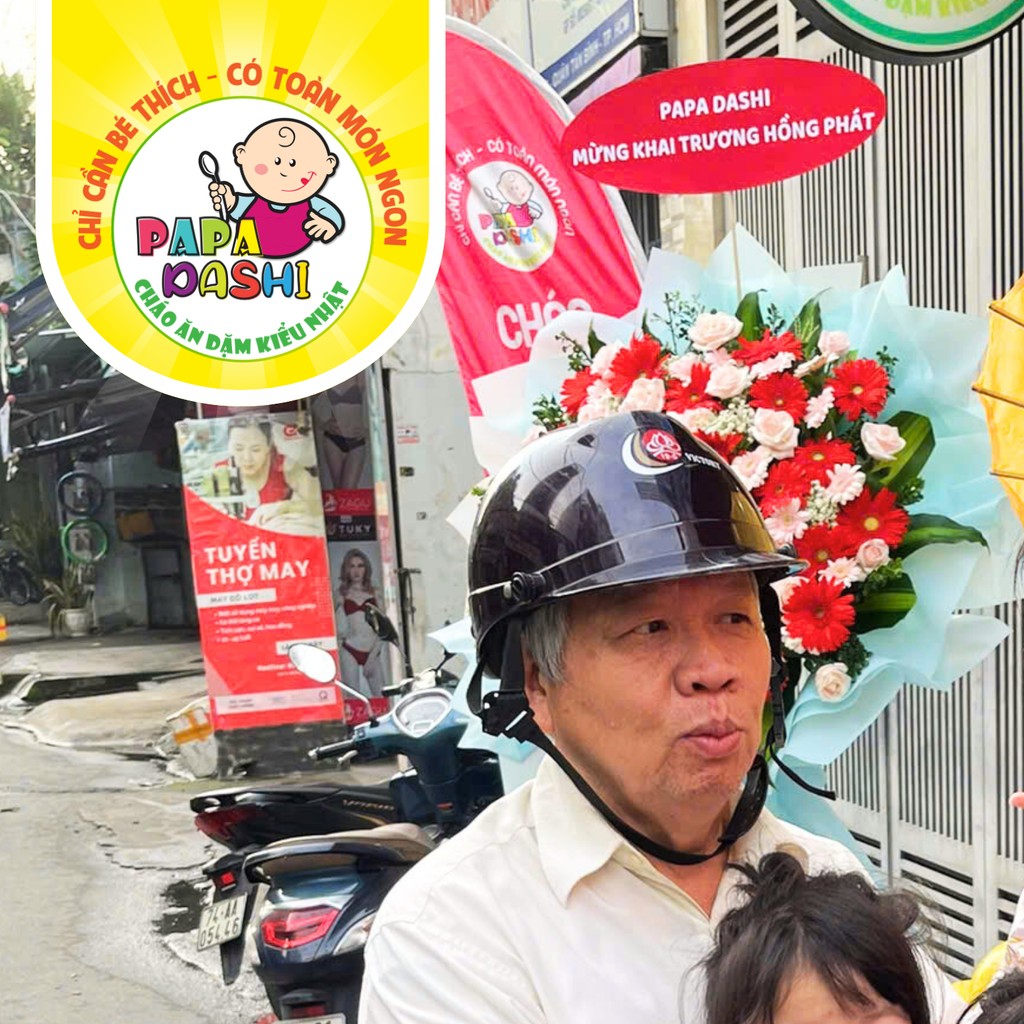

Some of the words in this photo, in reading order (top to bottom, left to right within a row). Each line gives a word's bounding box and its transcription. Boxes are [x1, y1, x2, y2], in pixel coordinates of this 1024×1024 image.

[660, 97, 709, 121] PAPA
[712, 88, 771, 113] DASHI
[573, 138, 629, 167] MỪNG
[633, 134, 676, 159] KHAI
[679, 126, 760, 154] TRƯƠNG
[763, 116, 820, 142] HỒNG
[823, 107, 876, 136] PHÁT
[338, 523, 371, 534] TUKY
[205, 537, 277, 564] TUYỂN
[207, 565, 253, 587] THỢ
[262, 561, 310, 581] MAY
